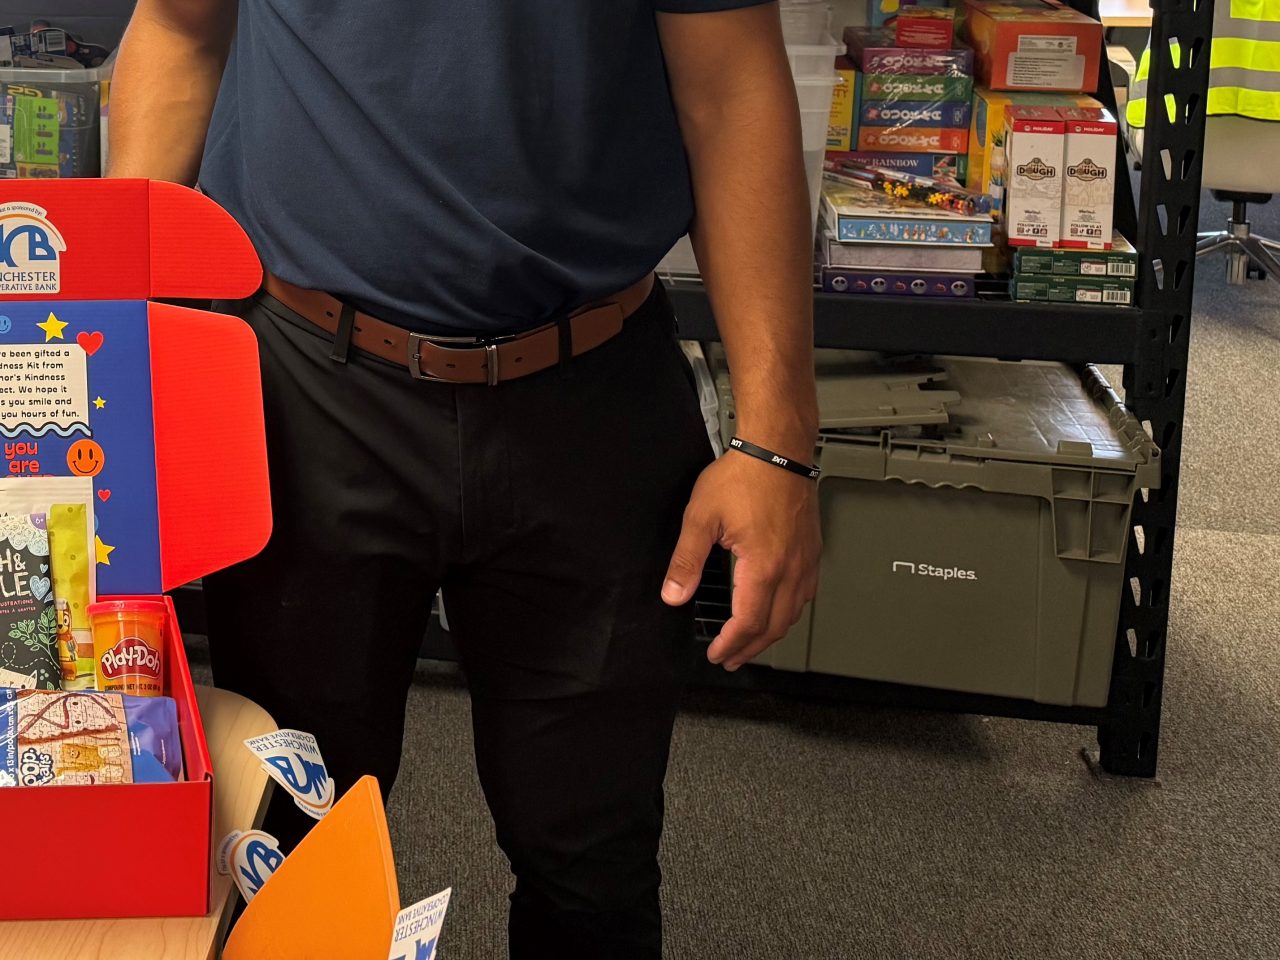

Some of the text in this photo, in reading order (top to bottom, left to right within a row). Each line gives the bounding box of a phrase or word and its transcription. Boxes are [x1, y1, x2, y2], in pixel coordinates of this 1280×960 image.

[879, 136, 940, 146] QUOKKA
[1020, 166, 1053, 176] DOUGH
[1070, 168, 1104, 177] DOUGH
[34, 350, 60, 358] gifted
[35, 386, 58, 394] hope
[4, 442, 38, 460] you
[9, 460, 39, 472] are
[102, 646, 160, 674] Play-Doh
[247, 736, 270, 746] BANK
[252, 739, 319, 755] WINCHESTER
